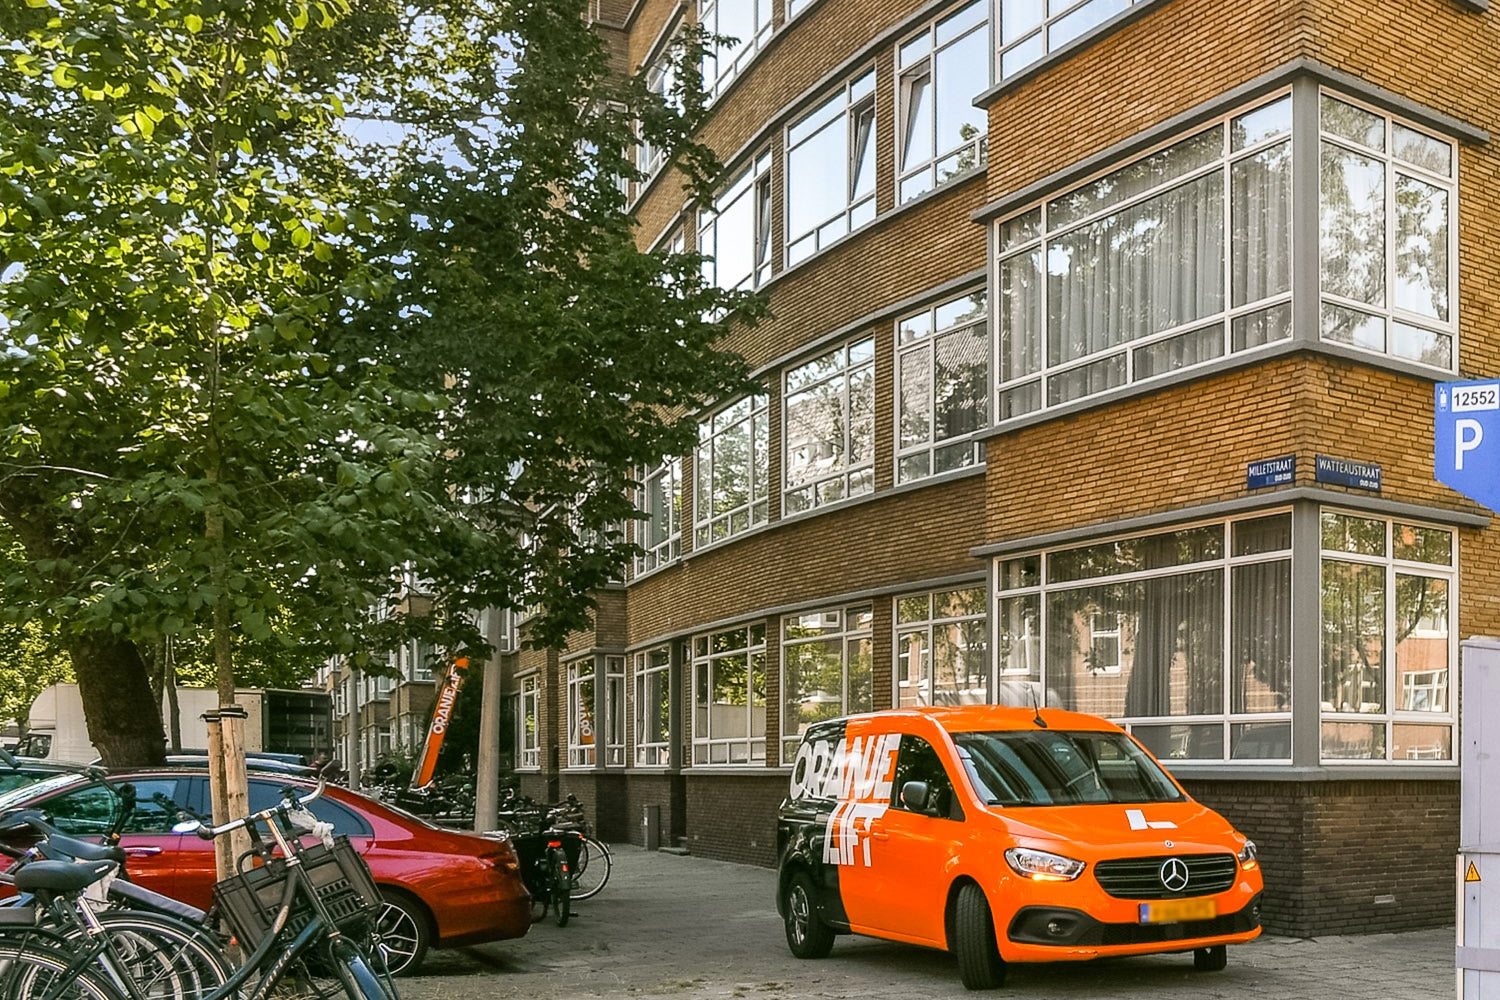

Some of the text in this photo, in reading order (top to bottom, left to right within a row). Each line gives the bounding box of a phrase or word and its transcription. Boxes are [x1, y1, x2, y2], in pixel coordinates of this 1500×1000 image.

[1454, 391, 1495, 406] 12552
[1455, 419, 1484, 470] P
[1249, 459, 1292, 477] MILLETSTRAAT
[1319, 459, 1380, 479] WATTEAUSTRAAT
[790, 733, 902, 800] ORANJE
[822, 802, 890, 867] LIFT
